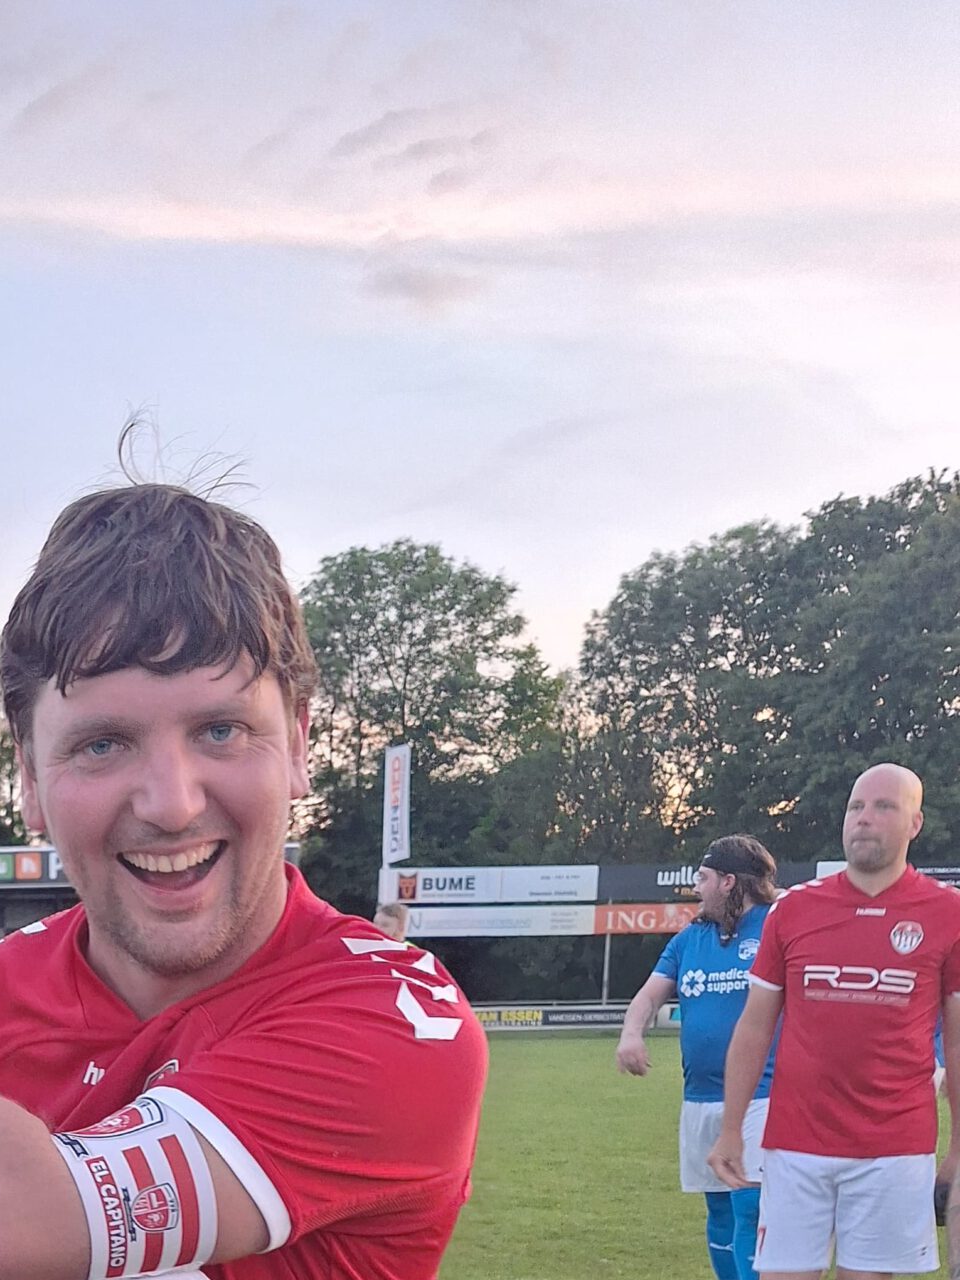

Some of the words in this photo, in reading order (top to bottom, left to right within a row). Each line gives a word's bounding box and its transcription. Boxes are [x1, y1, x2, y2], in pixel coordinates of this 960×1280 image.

[657, 866, 701, 886] wille
[606, 909, 657, 931] ING
[708, 968, 750, 980] medica
[803, 965, 918, 995] RDS
[707, 980, 750, 994] suppor
[90, 1160, 108, 1183] EL
[100, 1183, 126, 1268] CAPITANO
